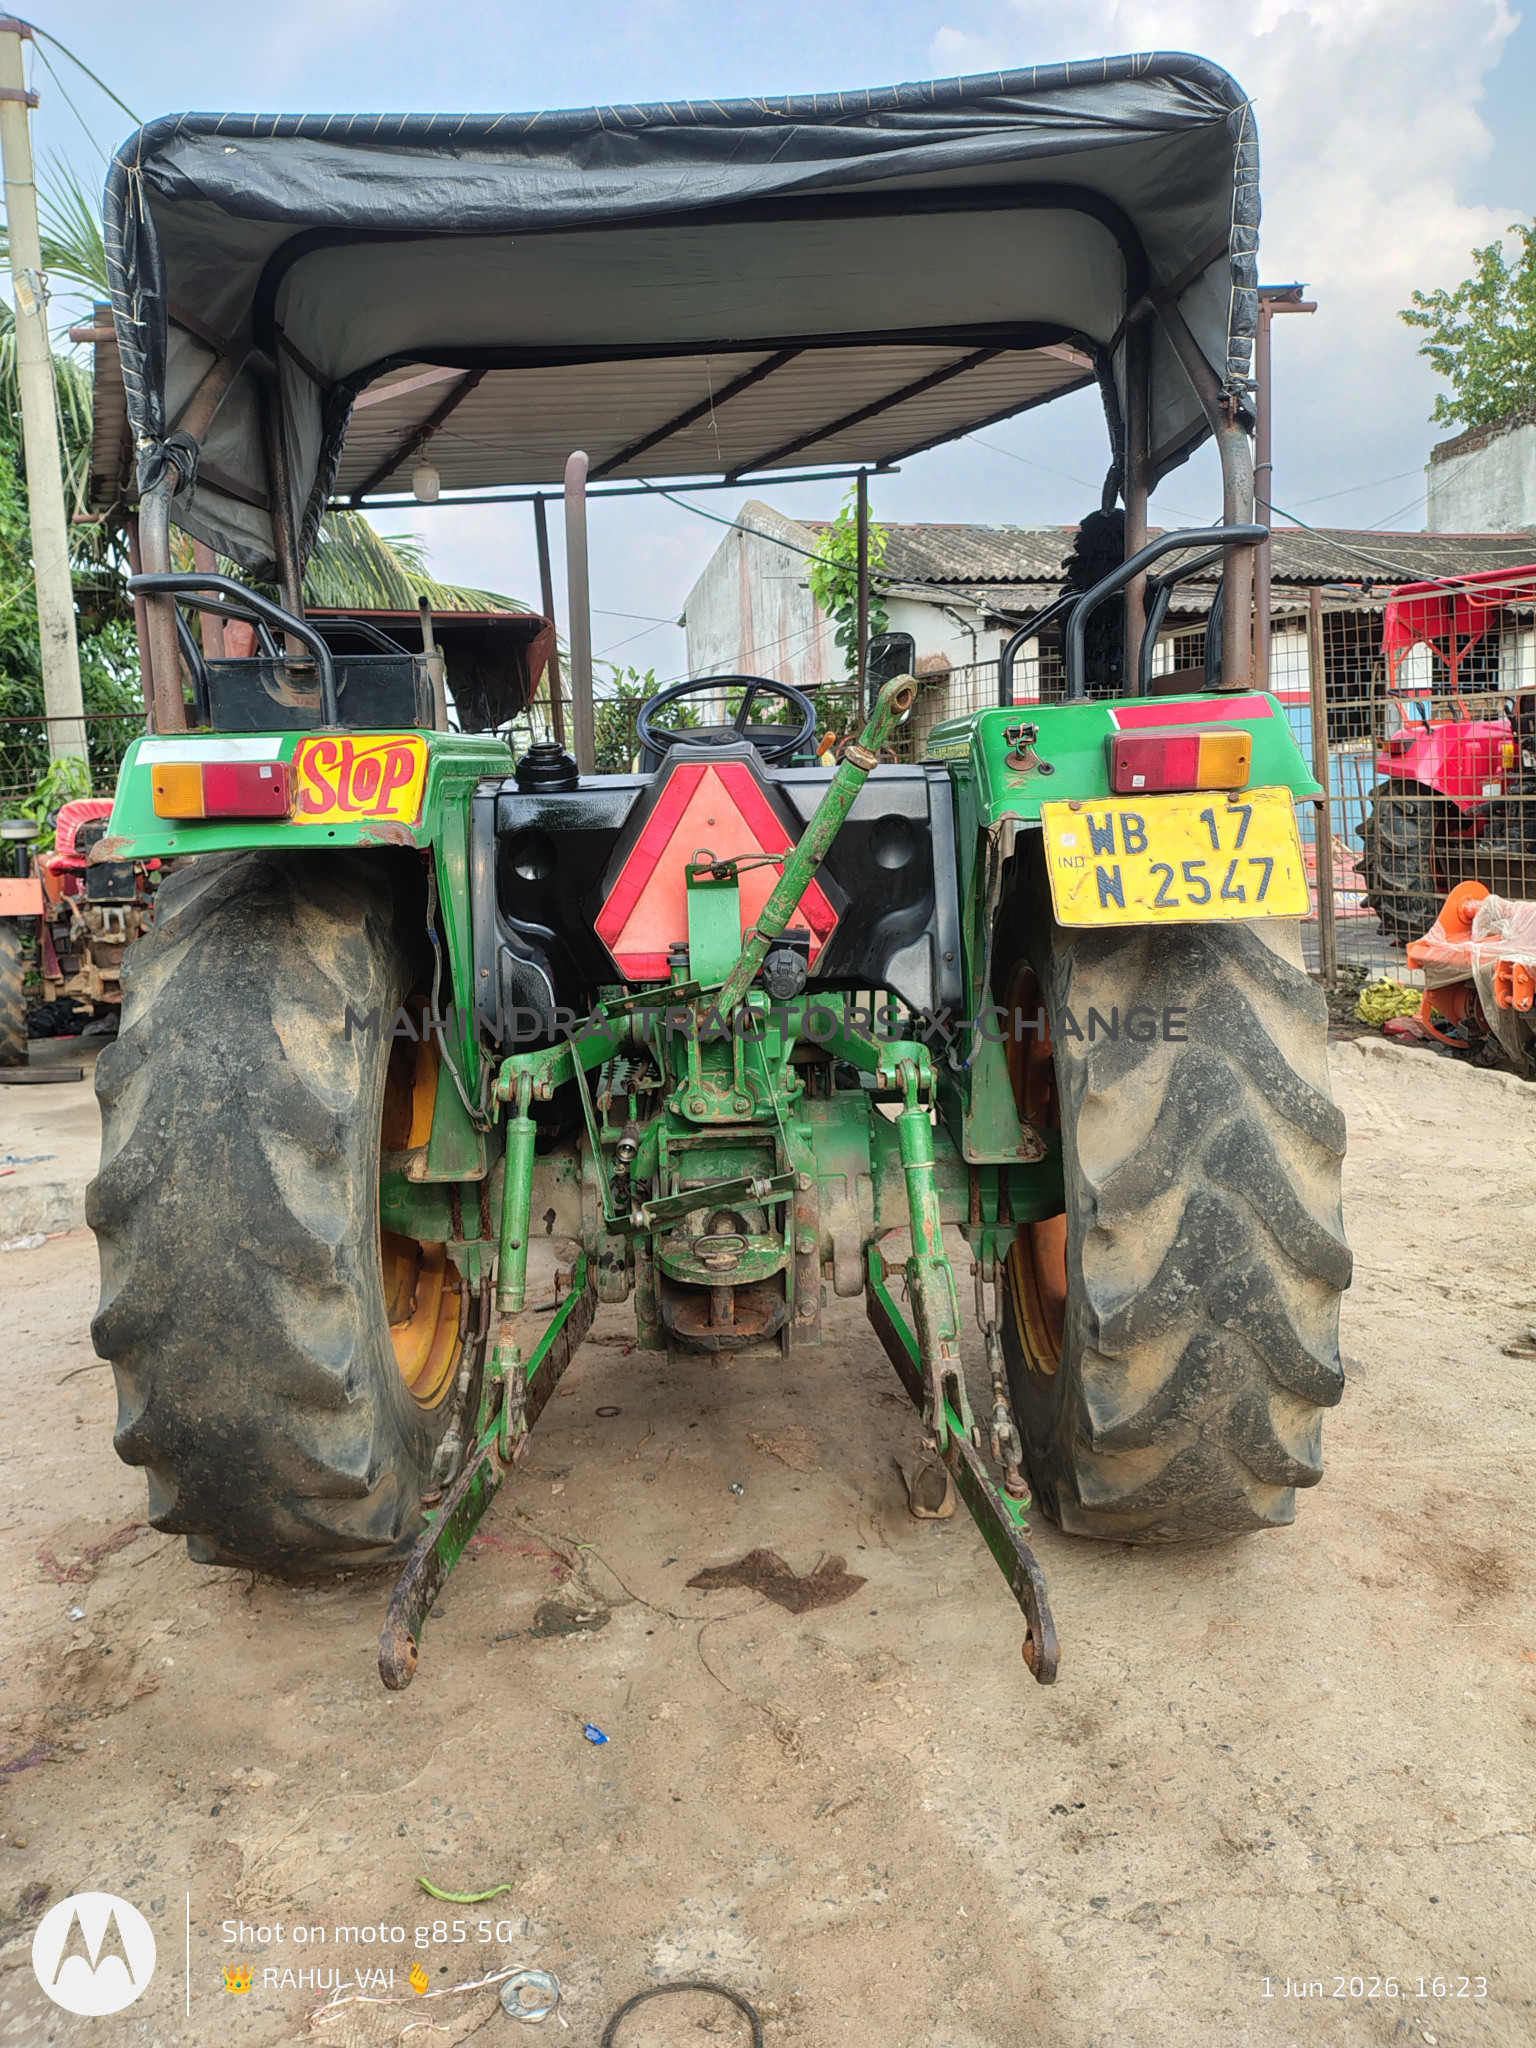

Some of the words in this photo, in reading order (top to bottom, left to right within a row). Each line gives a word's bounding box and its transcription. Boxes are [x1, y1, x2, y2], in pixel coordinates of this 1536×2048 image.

[1086, 812, 1149, 856] WB
[1200, 804, 1253, 851] 17
[1058, 856, 1085, 868] IND
[1096, 864, 1126, 909] N
[1149, 857, 1275, 908] 2547
